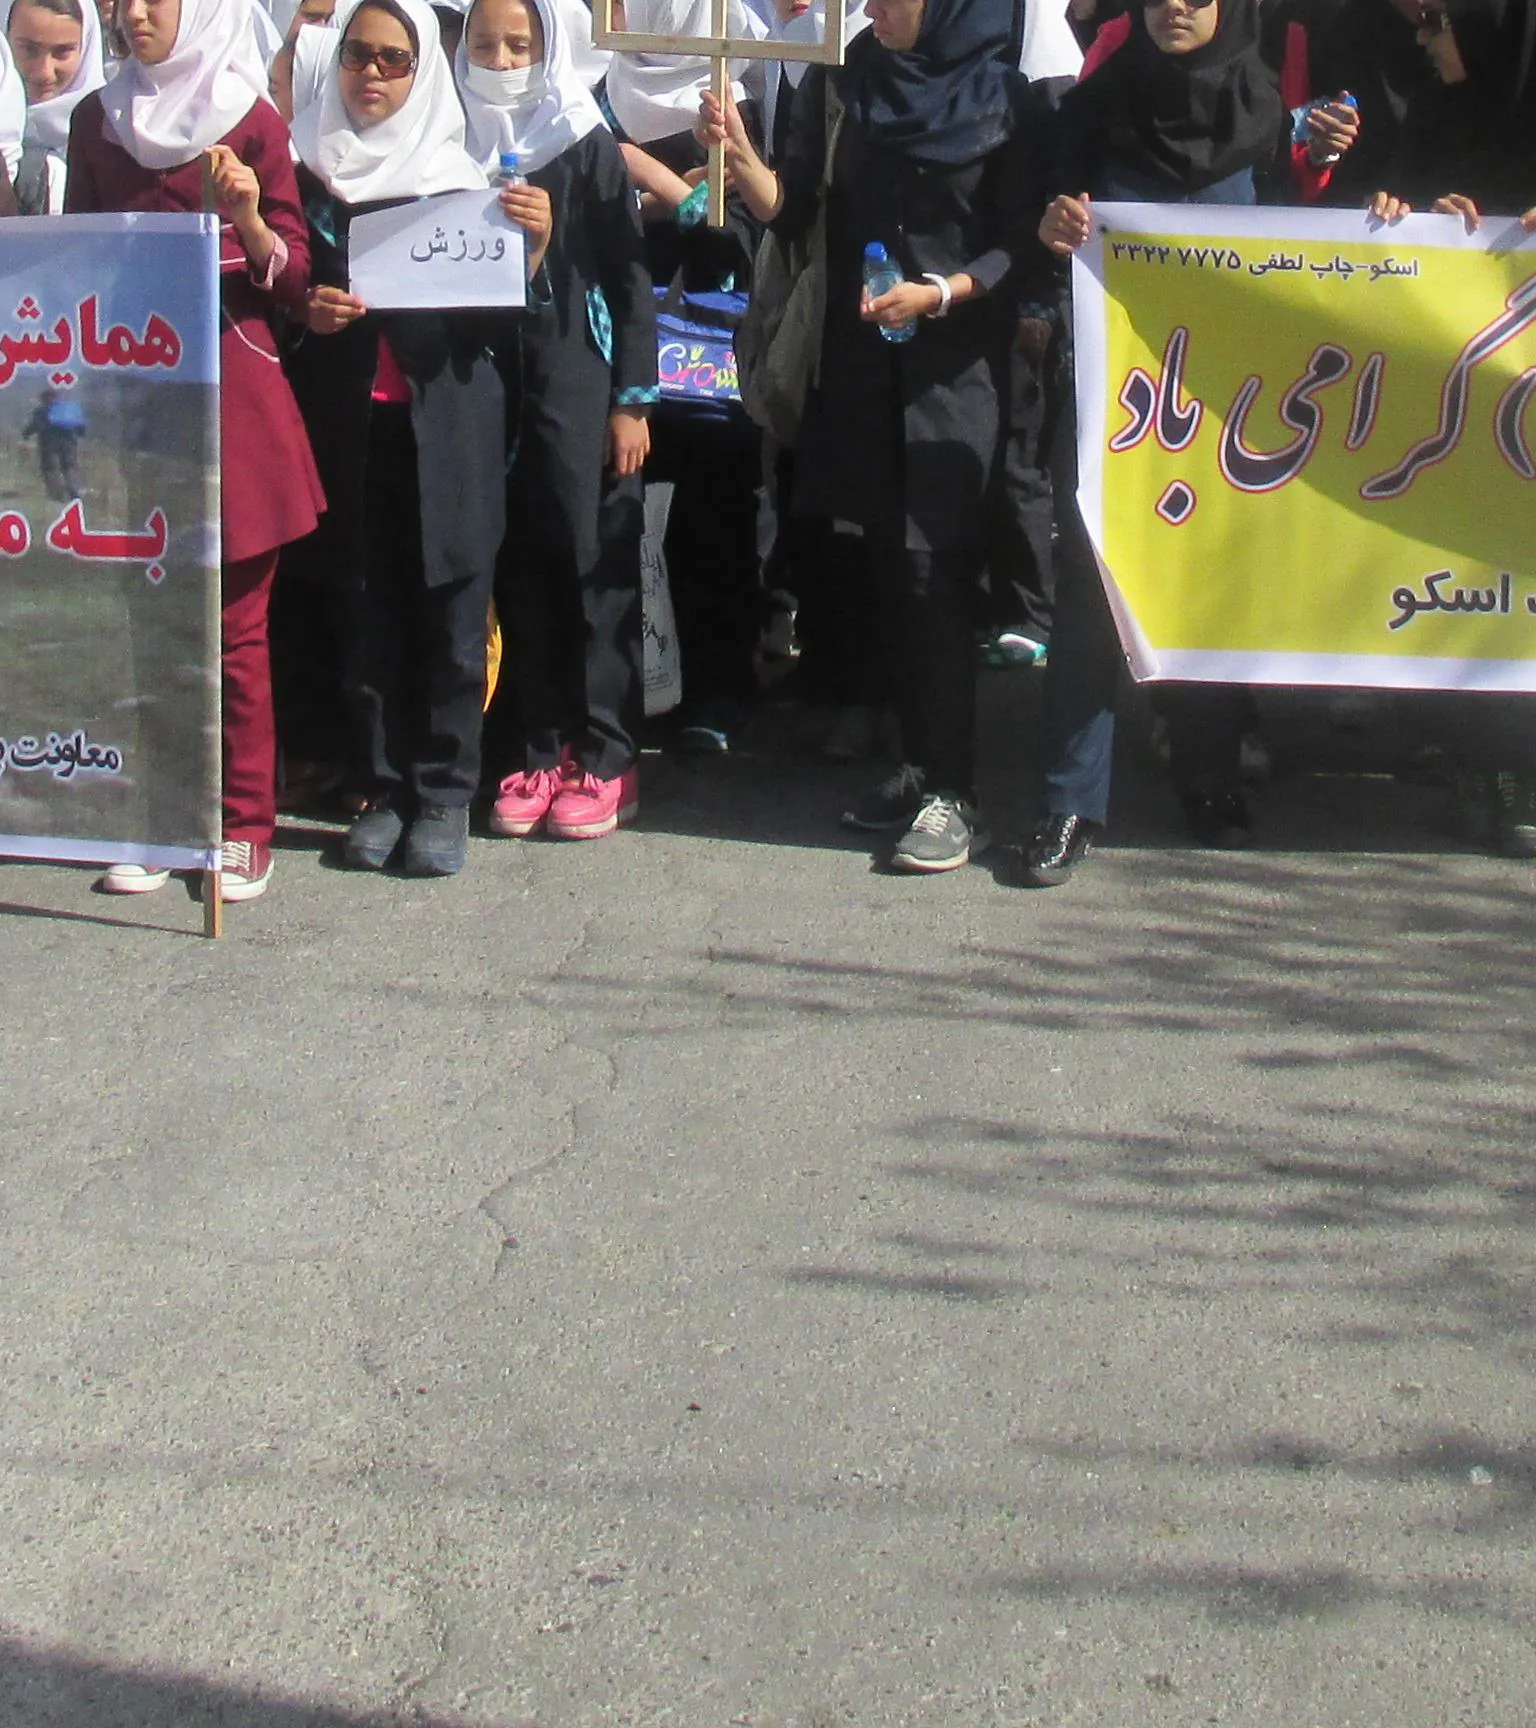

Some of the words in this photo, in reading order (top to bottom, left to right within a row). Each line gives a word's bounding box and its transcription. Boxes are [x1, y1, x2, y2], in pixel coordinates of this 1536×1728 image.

[409, 225, 506, 262] ورزش
[1248, 252, 1304, 278] لطفی
[1108, 325, 1205, 526] باد
[46, 495, 170, 585] به
[1387, 569, 1513, 630] اسکو
[11, 727, 123, 779] معاونت
